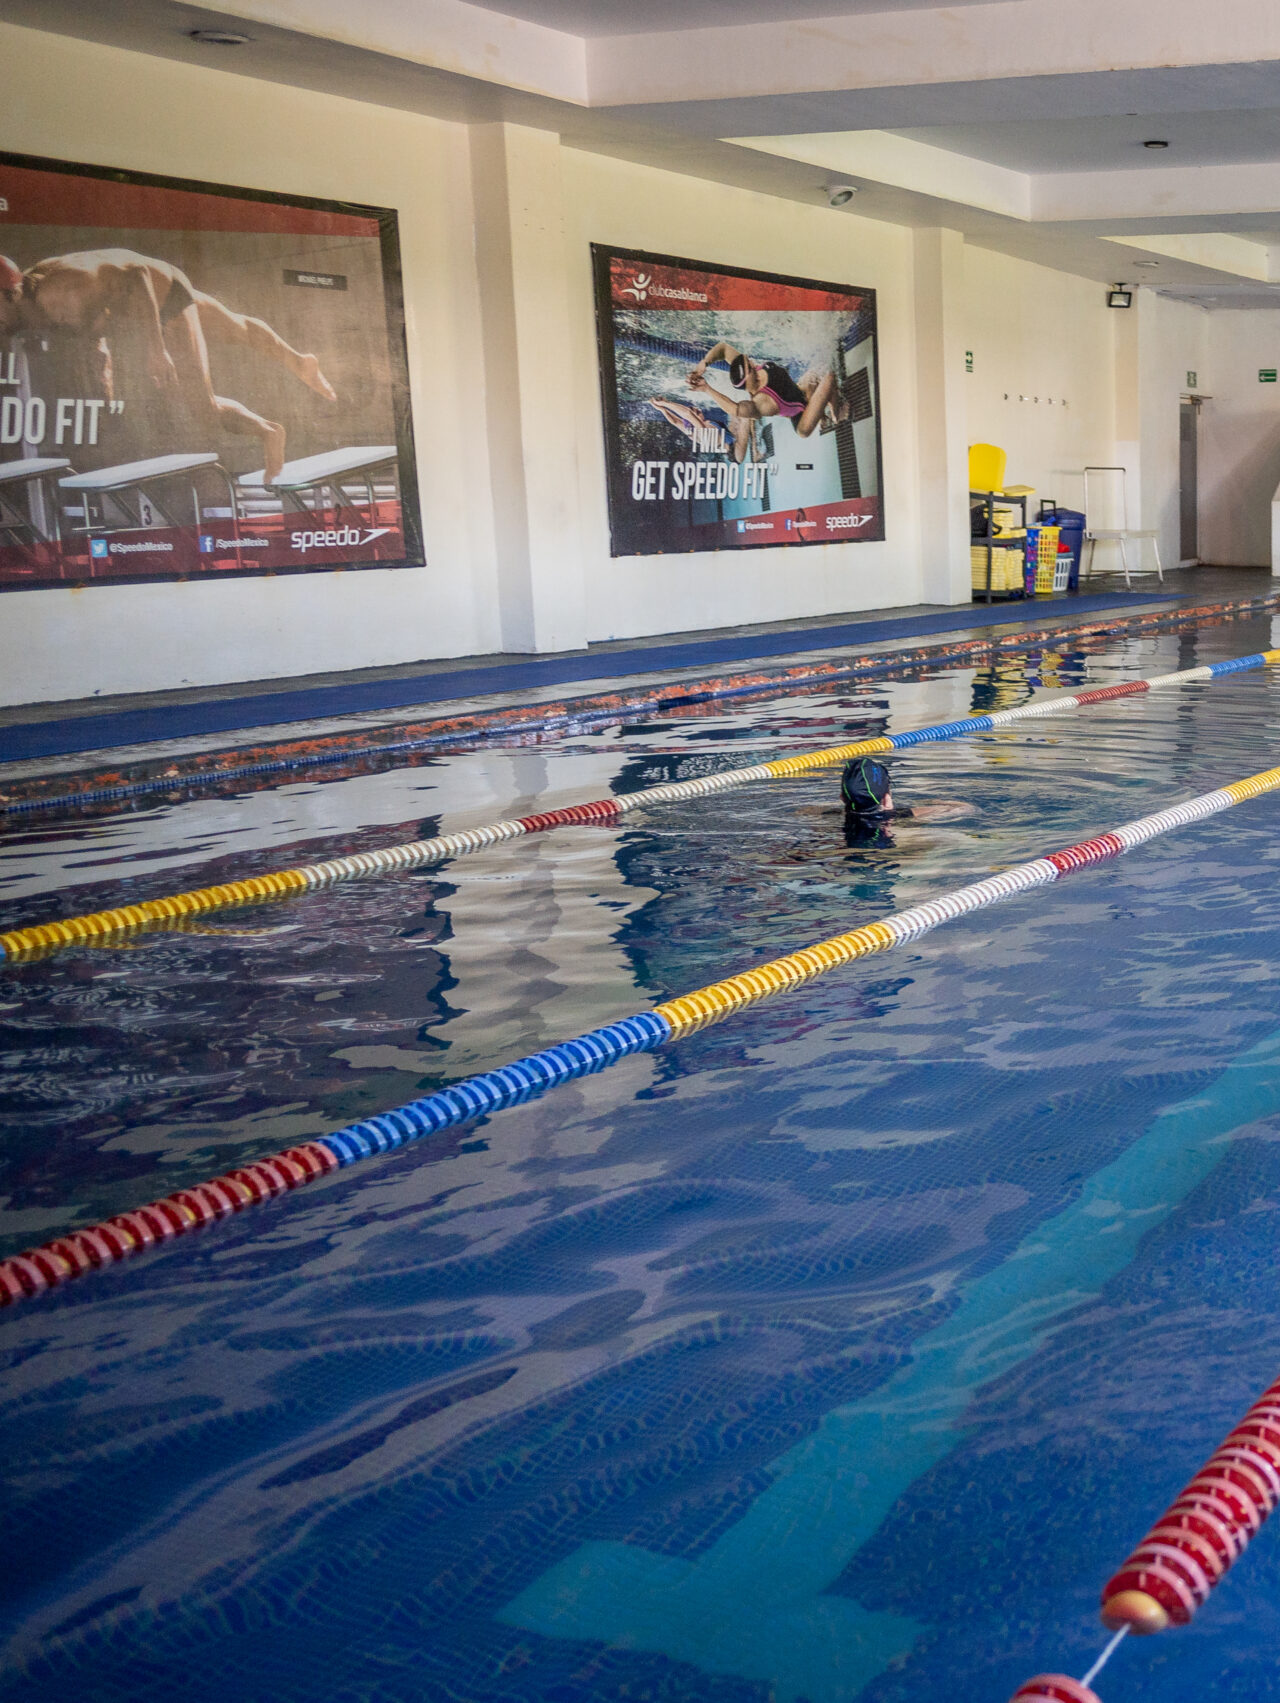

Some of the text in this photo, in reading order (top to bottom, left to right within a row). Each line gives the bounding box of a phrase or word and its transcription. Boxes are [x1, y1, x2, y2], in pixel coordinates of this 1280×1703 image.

[699, 427, 728, 453] WILL
[632, 460, 670, 501] GET
[671, 461, 740, 501] SPEEDO
[143, 504, 153, 526] 3
[825, 512, 859, 532] speedo
[291, 525, 360, 553] speedo
